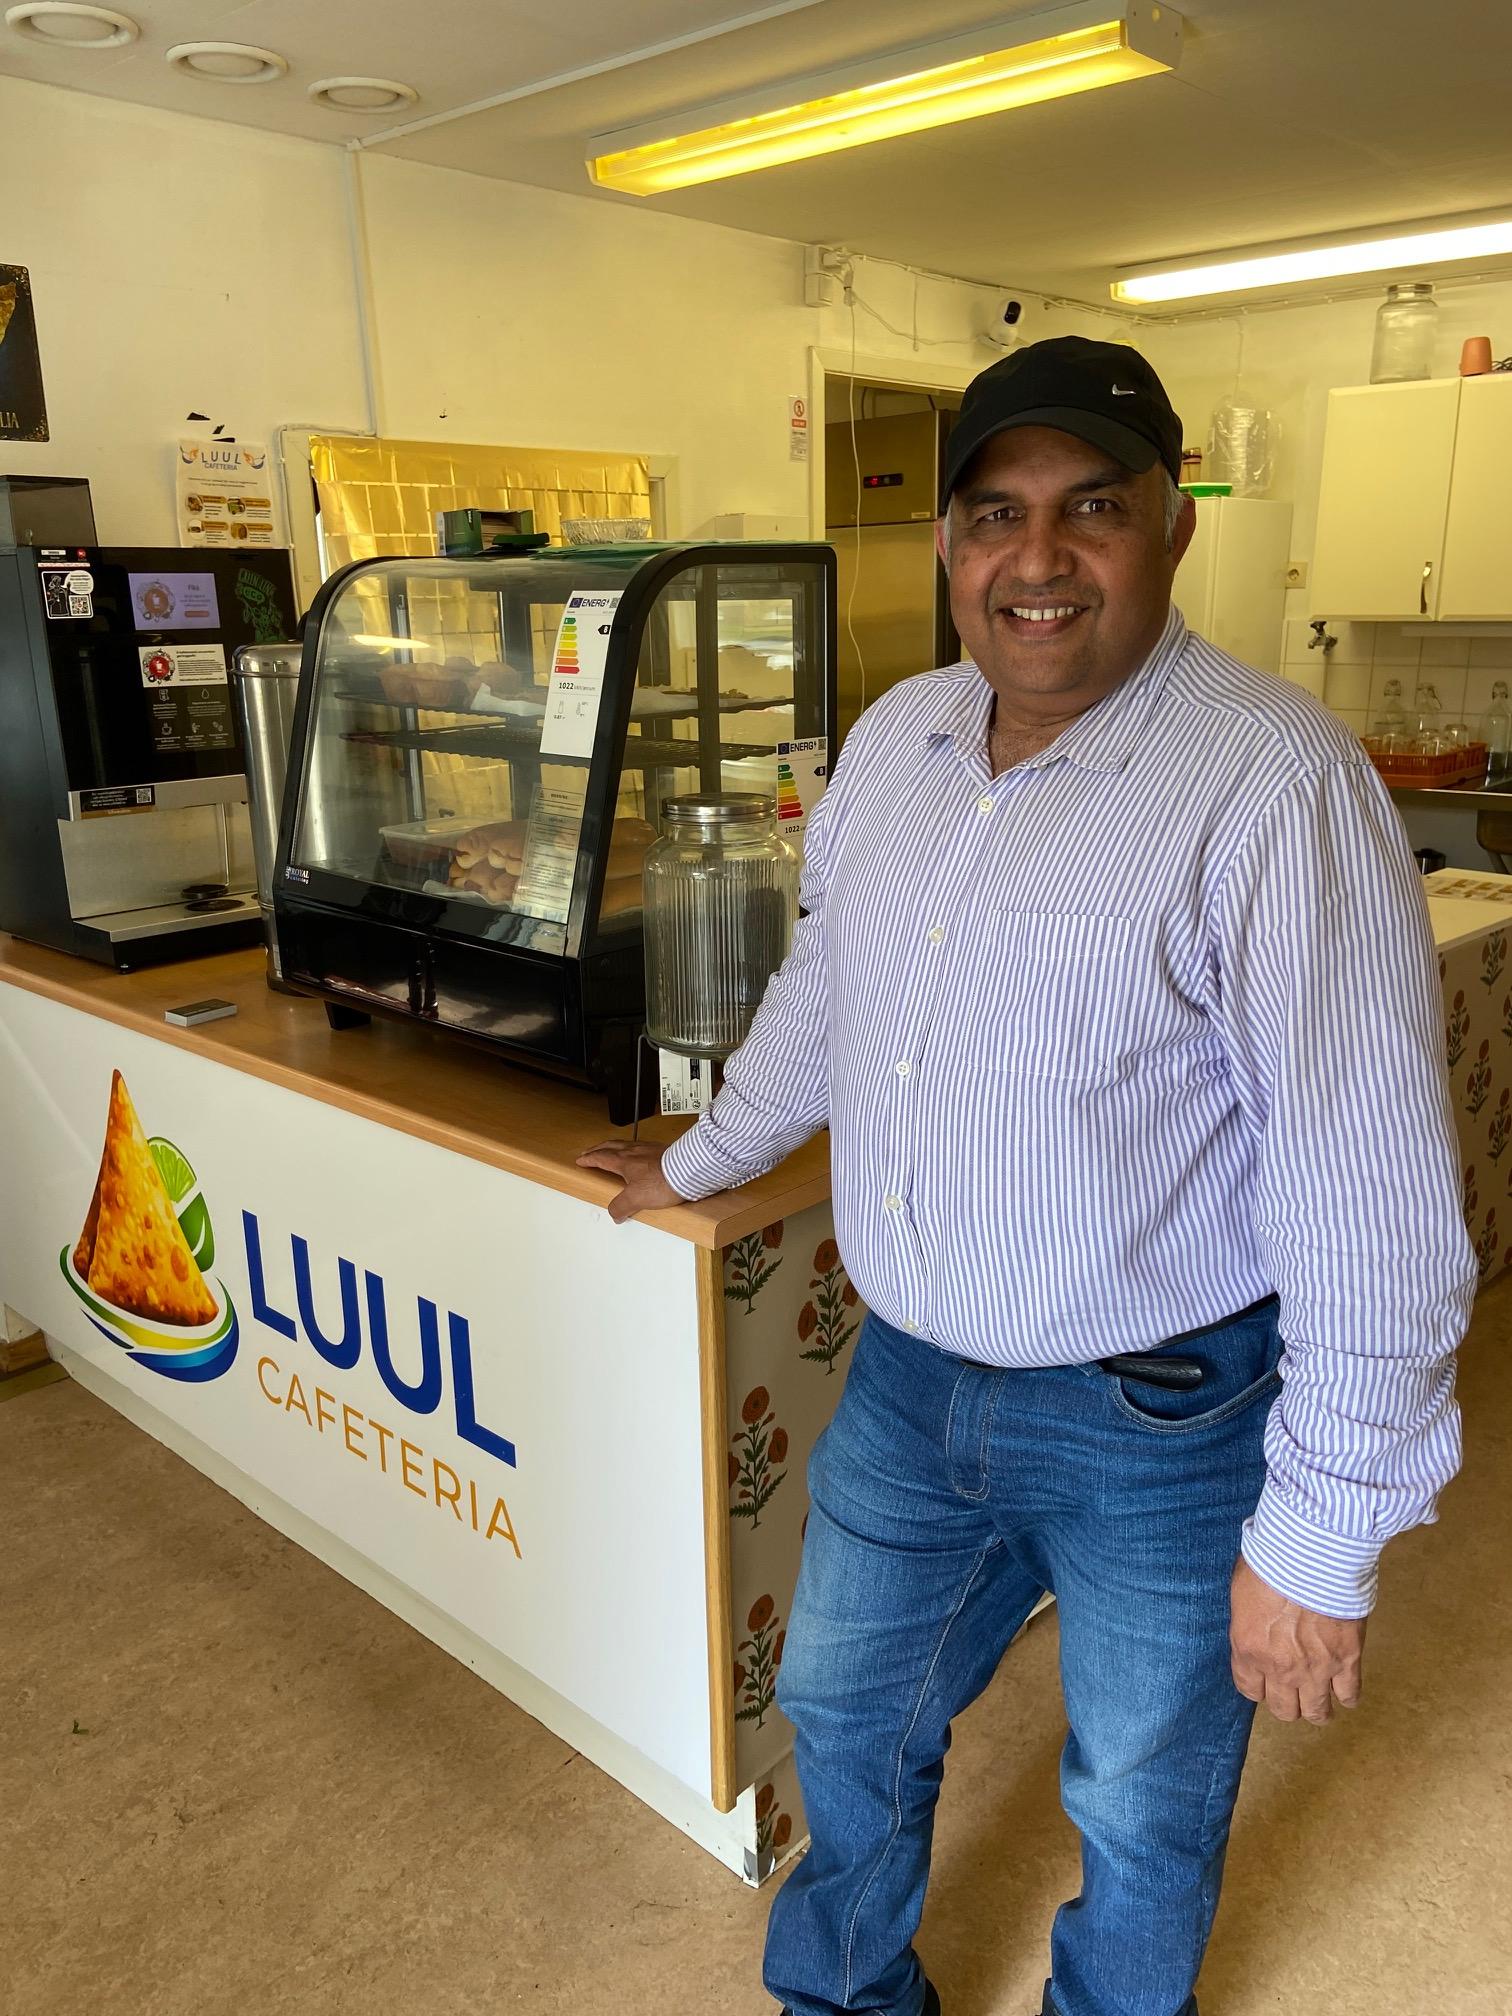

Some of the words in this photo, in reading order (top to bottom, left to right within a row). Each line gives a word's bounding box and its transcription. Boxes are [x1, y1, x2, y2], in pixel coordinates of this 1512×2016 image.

[201, 451, 242, 465] LUUL
[204, 462, 238, 470] CAFETERIA
[582, 599, 606, 608] ENERG
[558, 682, 574, 690] 1022
[790, 741, 814, 752] ENERG
[785, 826, 800, 834] 1022
[241, 1209, 517, 1469] LUUL
[257, 1356, 523, 1560] CAFETERIA
